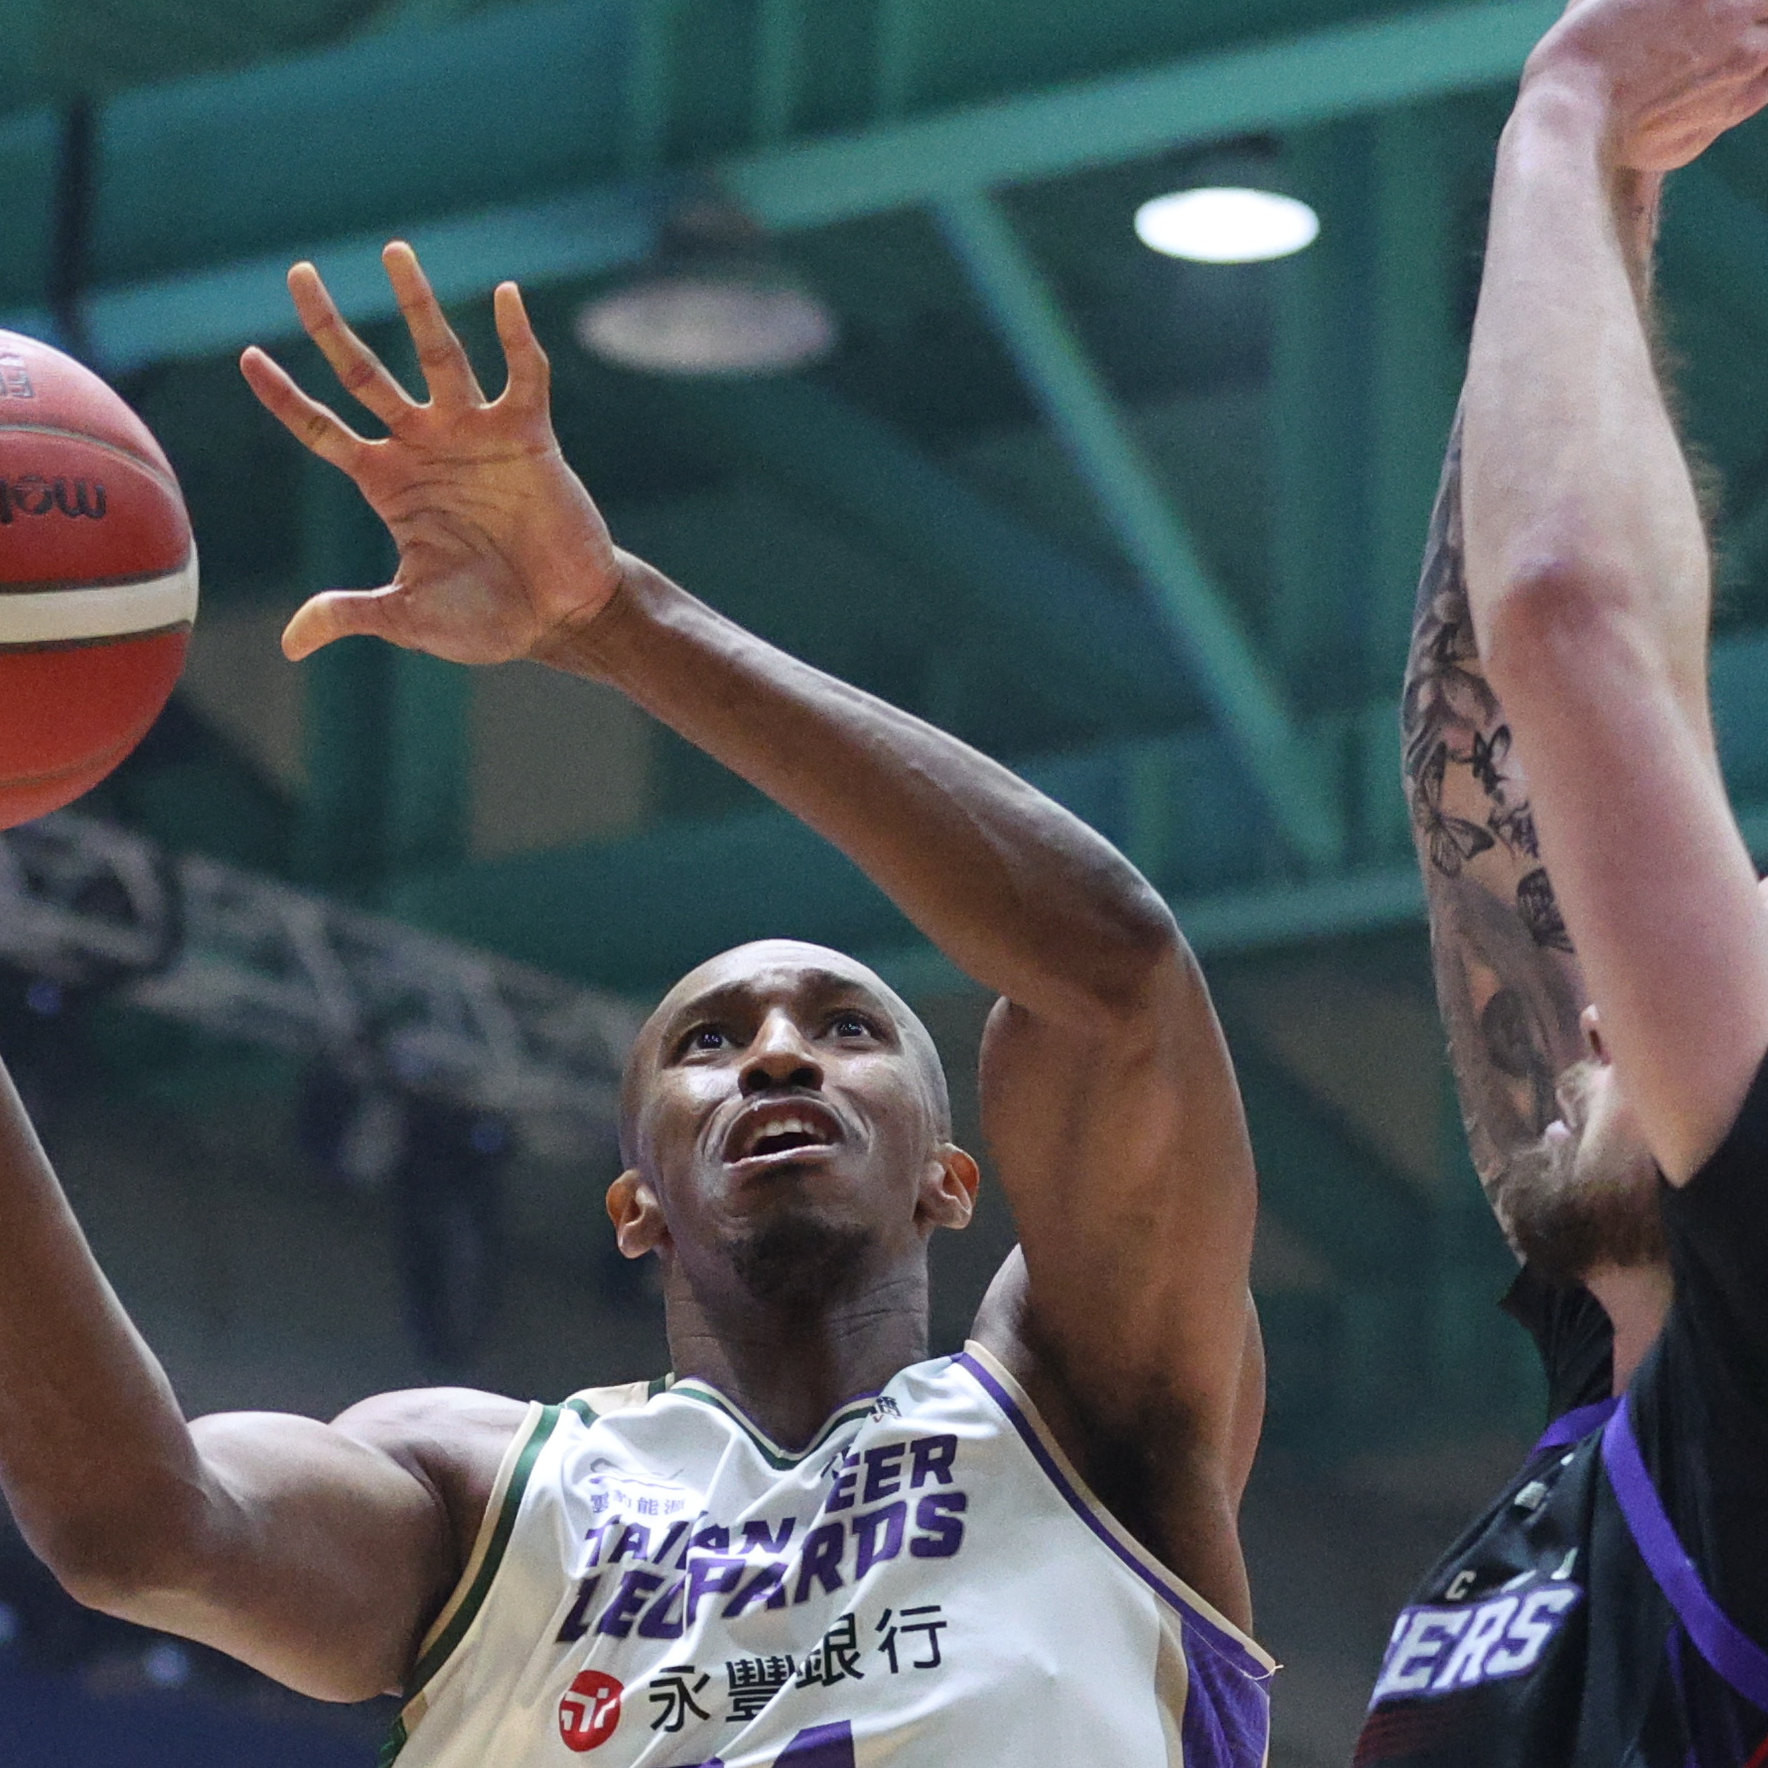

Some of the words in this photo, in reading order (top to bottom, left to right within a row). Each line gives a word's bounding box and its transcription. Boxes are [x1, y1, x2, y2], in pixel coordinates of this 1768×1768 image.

[648, 1604, 948, 1732] 永豐銀行
[1368, 1586, 1580, 1706] ERS
